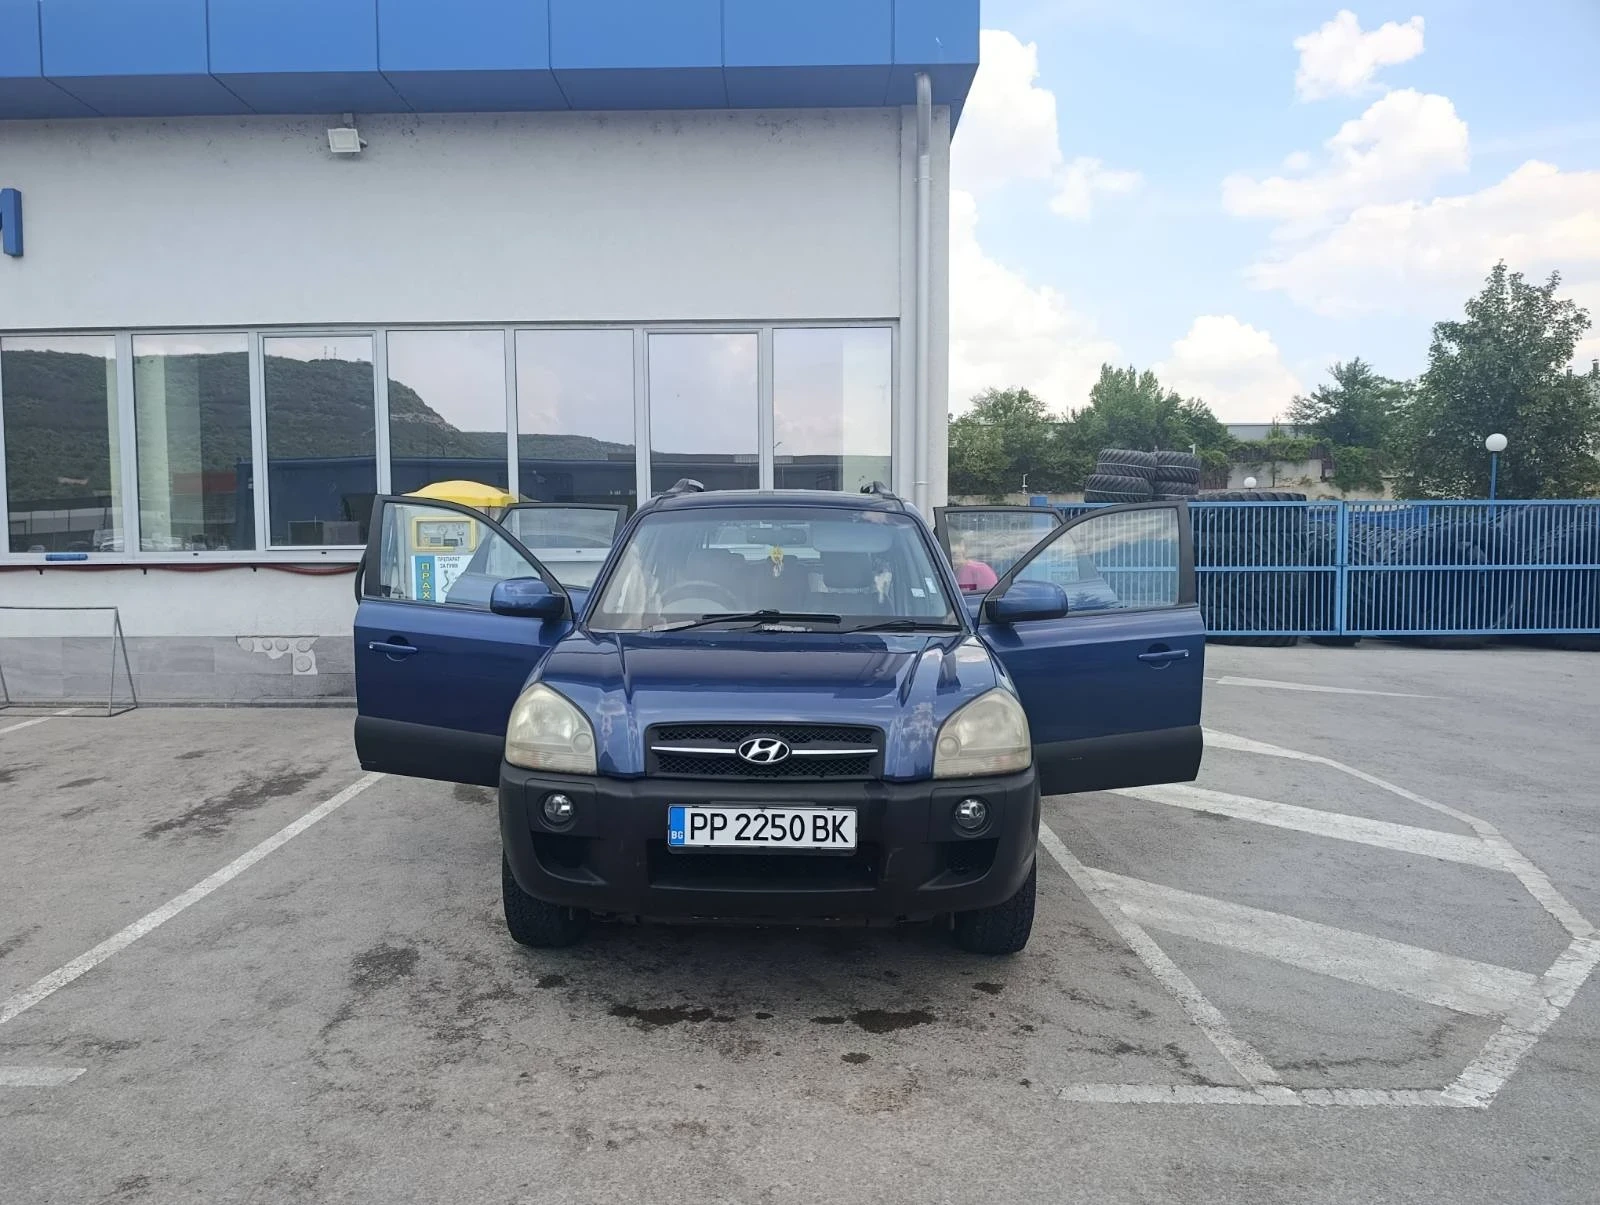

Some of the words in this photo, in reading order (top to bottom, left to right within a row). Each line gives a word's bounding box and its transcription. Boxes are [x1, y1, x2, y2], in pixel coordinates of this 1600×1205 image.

[421, 563, 431, 600] ПРАХ
[671, 830, 684, 840] BG
[690, 812, 728, 841] PP
[734, 813, 806, 842] 2250
[812, 814, 849, 843] BK
